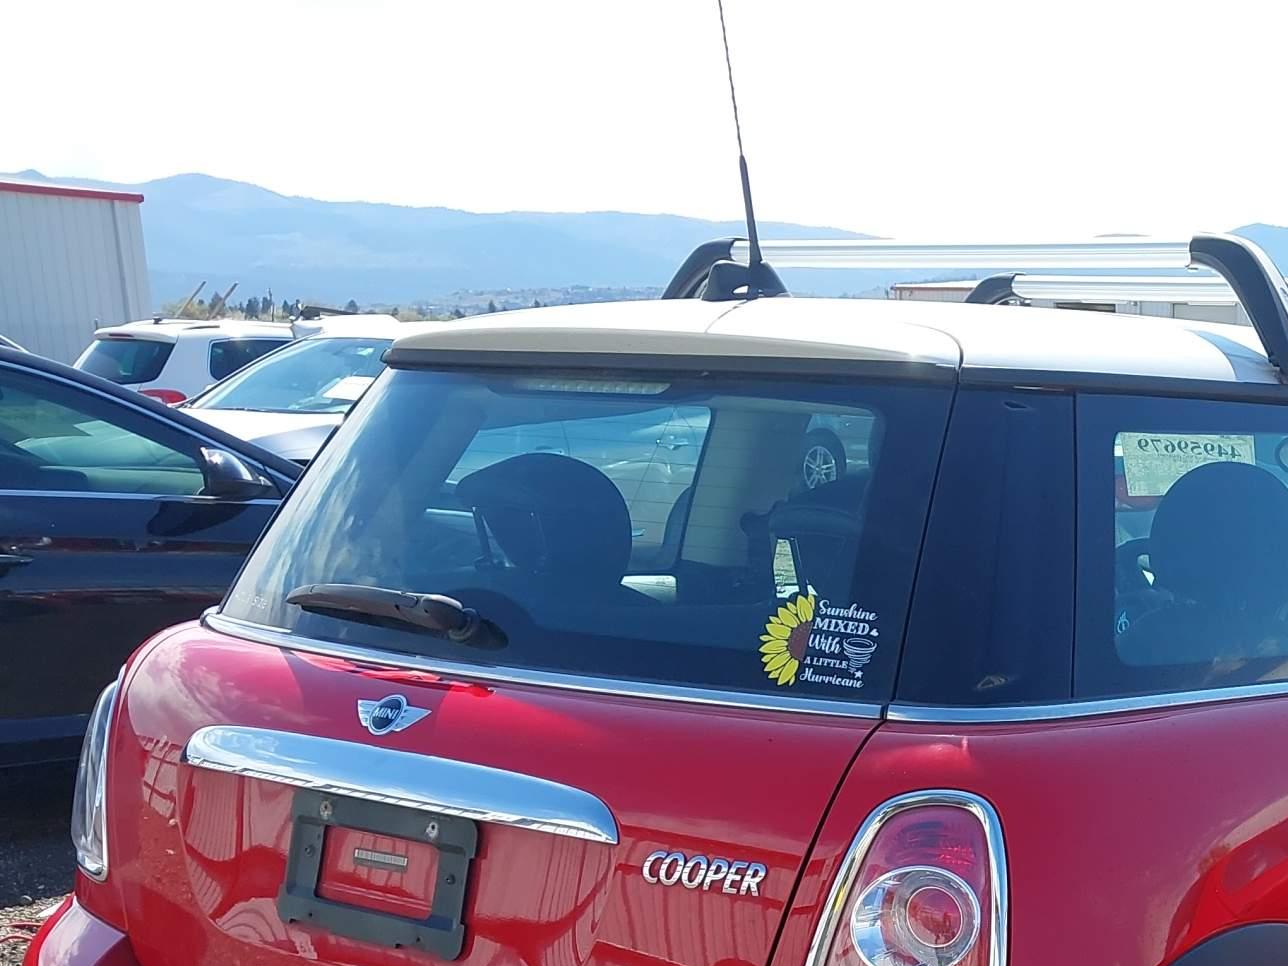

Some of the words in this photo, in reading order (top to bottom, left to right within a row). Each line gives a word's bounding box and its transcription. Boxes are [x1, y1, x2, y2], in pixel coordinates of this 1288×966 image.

[819, 599, 877, 621] Sunshine
[813, 617, 870, 636] MIXED
[808, 633, 841, 653] With
[804, 656, 812, 665] A
[812, 658, 849, 669] LITTLE
[799, 667, 864, 688] Hurricane
[373, 706, 399, 719] MINI
[642, 850, 767, 897] COOPER
